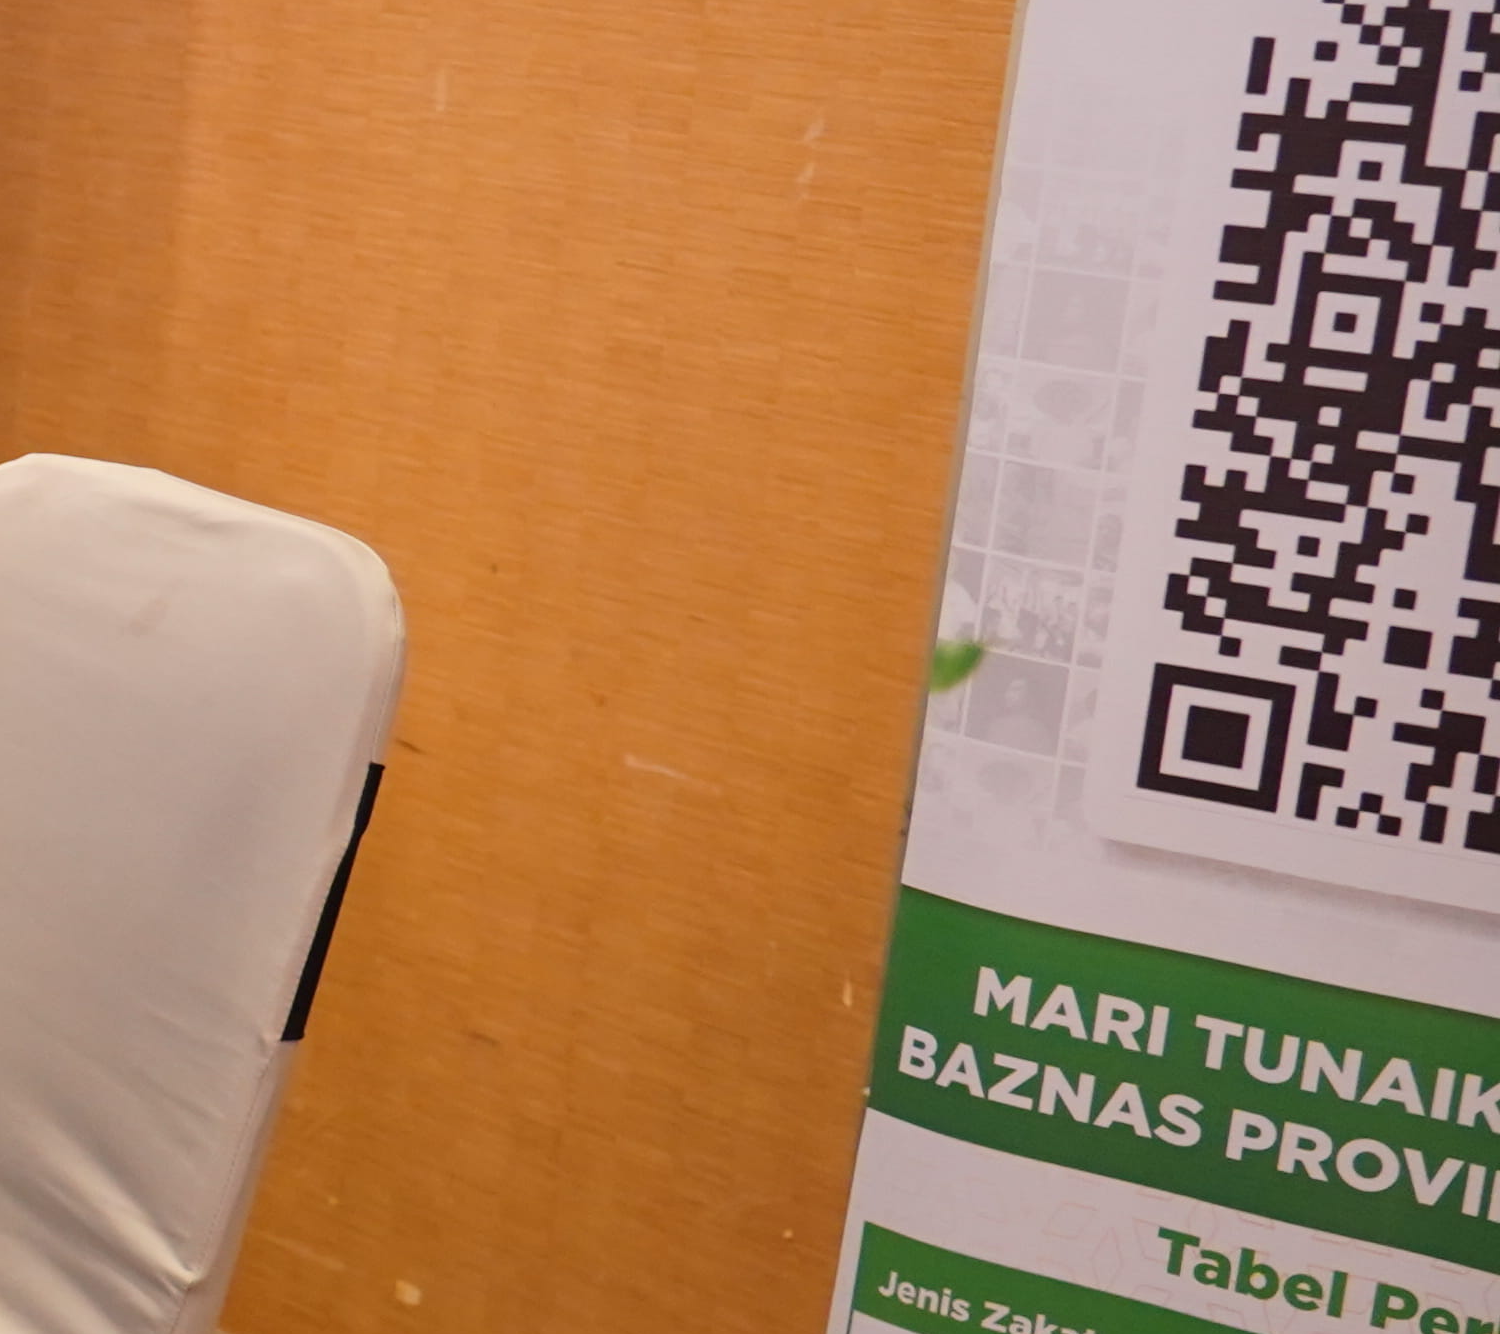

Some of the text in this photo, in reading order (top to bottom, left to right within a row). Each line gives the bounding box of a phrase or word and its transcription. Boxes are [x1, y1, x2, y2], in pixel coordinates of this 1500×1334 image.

[972, 967, 1170, 1057] MARI
[897, 1025, 1203, 1148] BAZNAS
[878, 1271, 971, 1322] Jenis
[1156, 1227, 1348, 1318] Tabel
